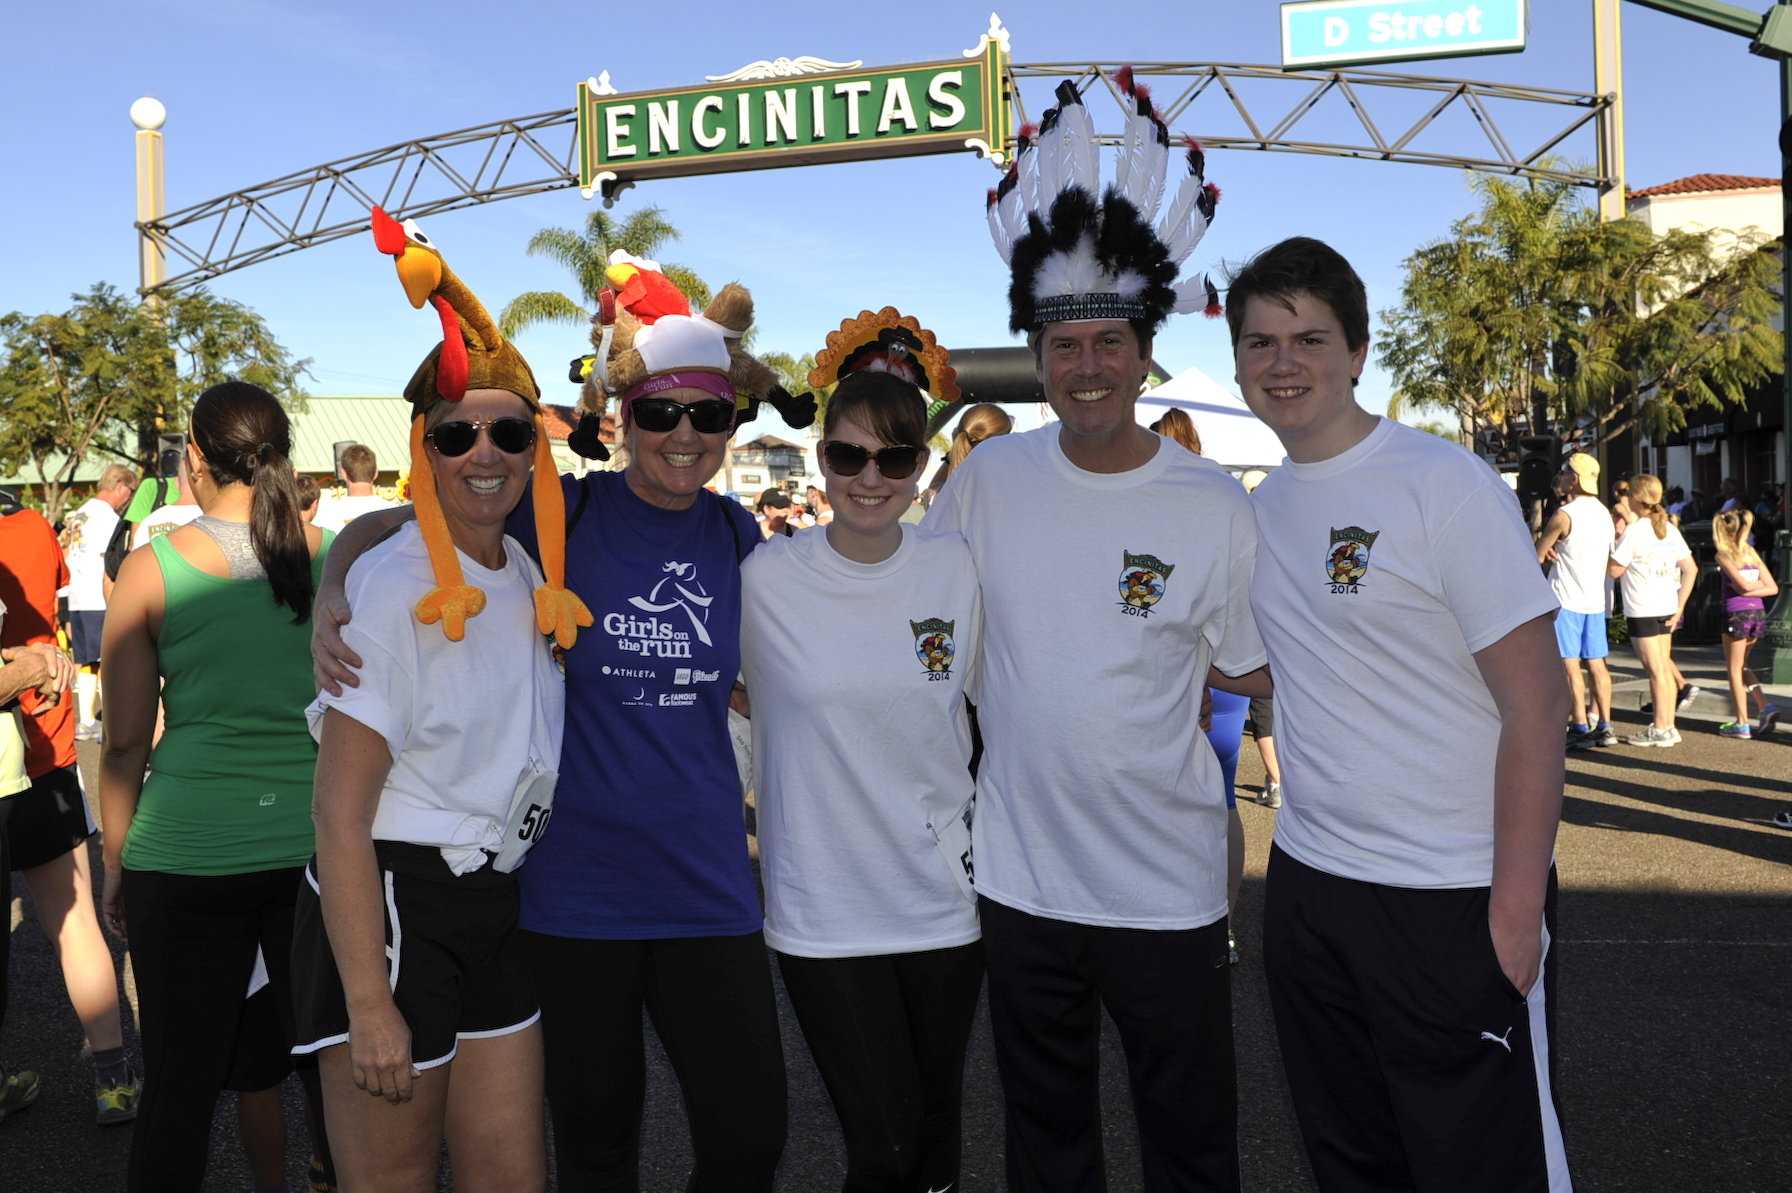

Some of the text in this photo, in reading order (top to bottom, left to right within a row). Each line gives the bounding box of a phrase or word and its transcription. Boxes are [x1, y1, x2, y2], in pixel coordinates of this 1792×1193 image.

[1324, 4, 1482, 47] D Street
[605, 70, 966, 159] ENCINITAS
[1335, 532, 1370, 542] ENCINITAS
[1129, 557, 1167, 574] ENCINITAS
[1330, 584, 1359, 595] 2014
[1121, 605, 1149, 619] 2014
[603, 612, 689, 641] Girls on
[618, 638, 692, 659] the run
[612, 667, 656, 679] ATHLETA
[928, 672, 950, 682] 2014
[670, 693, 697, 701] FAMOUS
